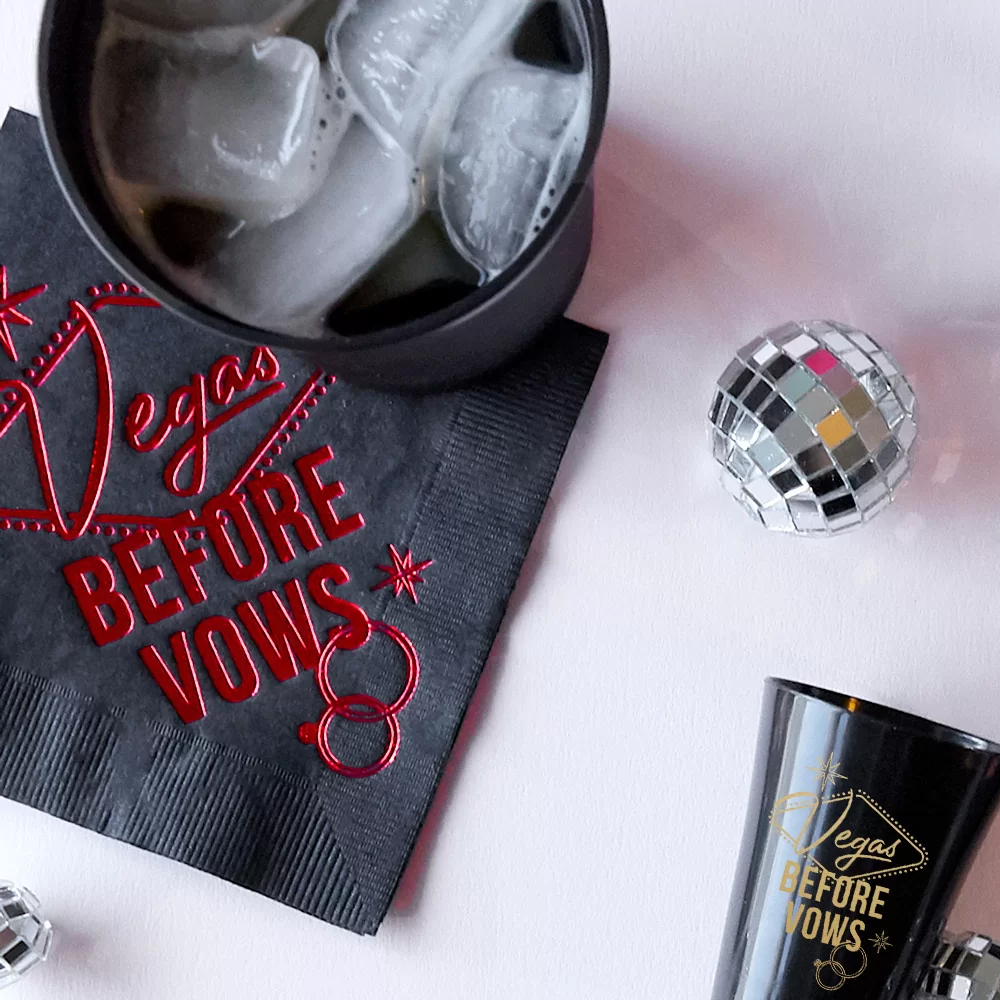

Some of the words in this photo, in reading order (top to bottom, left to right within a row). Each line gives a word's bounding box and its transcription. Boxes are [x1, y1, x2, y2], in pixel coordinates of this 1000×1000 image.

[62, 445, 366, 646] BEFORE
[138, 563, 373, 725] VOWS
[772, 788, 902, 872] Vegas
[779, 859, 890, 919] BEFORE
[785, 901, 866, 952] VOWS
